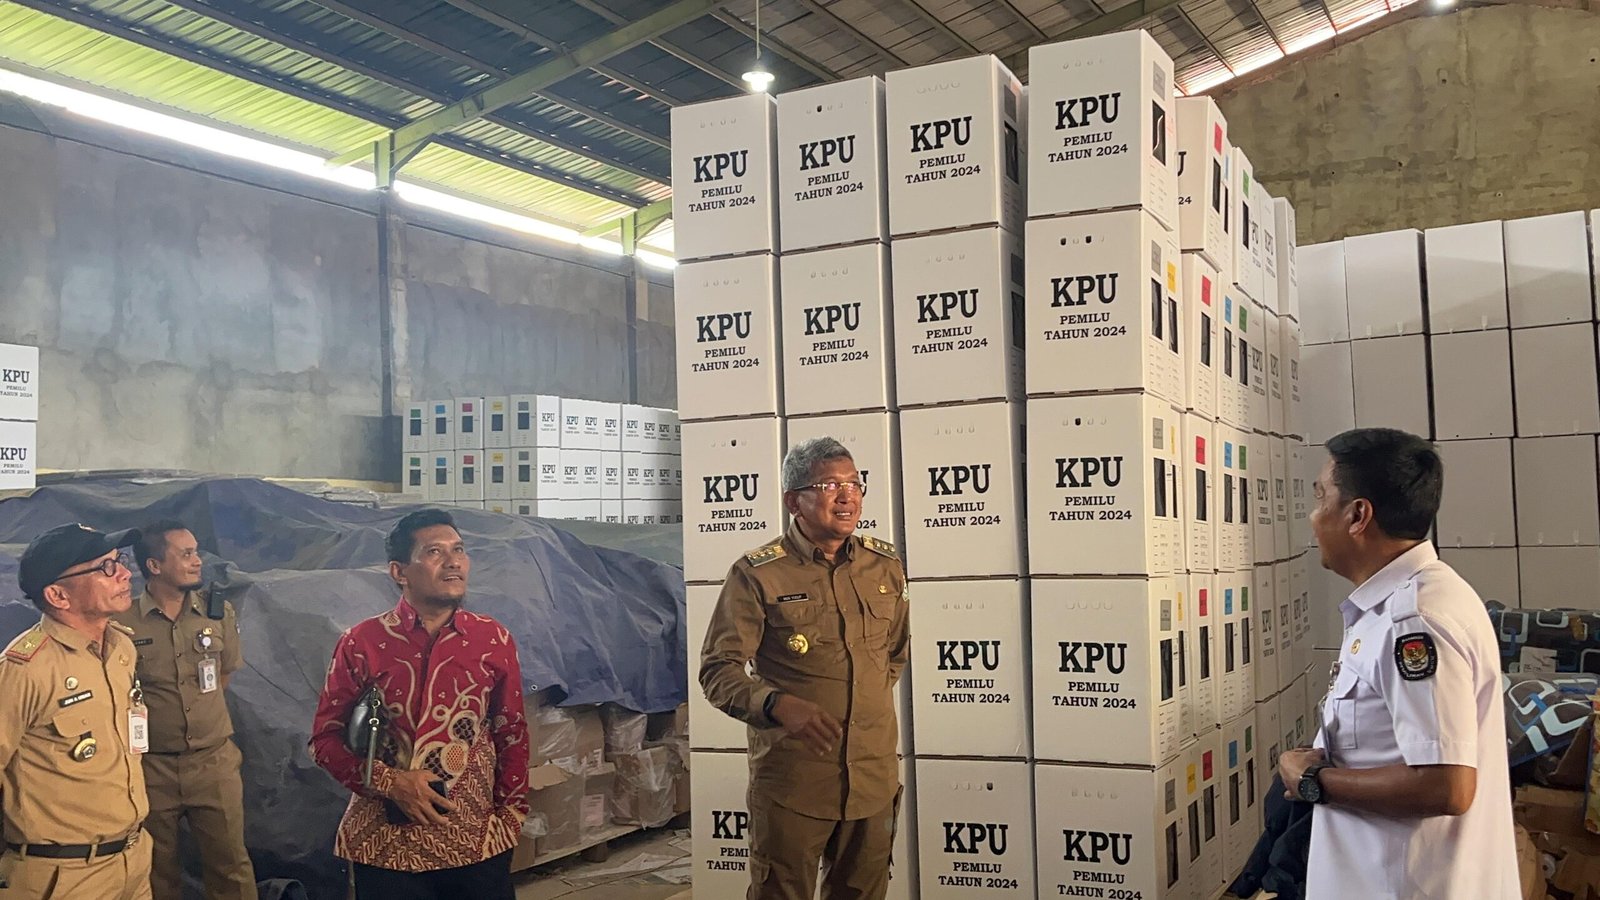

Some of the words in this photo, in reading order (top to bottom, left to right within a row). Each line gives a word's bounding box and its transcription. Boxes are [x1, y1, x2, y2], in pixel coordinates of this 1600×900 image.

[1055, 92, 1121, 130] KPU
[910, 116, 972, 153] KPU
[1064, 131, 1112, 147] PEMILU
[799, 135, 855, 171] KPU
[1048, 148, 1092, 162] TAHUN
[1096, 144, 1128, 156] 2024
[693, 150, 748, 183] KPU
[920, 153, 965, 169] PEMILU
[808, 171, 849, 186] PEMILU
[905, 170, 947, 184] TAHUN
[951, 165, 981, 177] 2024
[701, 184, 742, 198] PEMILU
[794, 187, 832, 201] TAHUN
[836, 182, 863, 194] 2024
[688, 200, 725, 212] TAHUN
[729, 196, 756, 207] 2024
[1178, 196, 1192, 205] 24
[1051, 273, 1118, 308] KPU
[917, 288, 979, 323] KPU
[804, 302, 861, 336] KPU
[1060, 312, 1110, 325] PEMILU
[696, 311, 752, 343] KPU
[926, 326, 972, 339] PEMILU
[1044, 328, 1089, 340] TAHUN
[1094, 326, 1126, 337] 2024
[813, 338, 855, 351] PEMILU
[912, 341, 953, 354] TAHUN
[958, 338, 988, 350] 2024
[705, 346, 746, 358] PEMILU
[799, 354, 838, 366] TAHUN
[841, 350, 869, 361] 2024
[692, 361, 729, 372] TAHUN
[733, 358, 759, 368] 2024
[3, 368, 30, 383] KPU
[542, 412, 555, 422] KPU
[566, 416, 579, 425] KPU
[585, 416, 597, 426] KPU
[605, 419, 617, 428] KPU
[626, 420, 638, 428] KPU
[644, 422, 655, 431] KPU
[659, 424, 670, 432] KPU
[0, 447, 27, 460] KPU
[542, 464, 555, 473] KPU
[564, 466, 577, 475] KPU
[584, 466, 597, 475] KPU
[606, 468, 618, 476] KPU
[628, 468, 639, 477] KPU
[644, 469, 654, 477] KPU
[659, 469, 670, 477] KPU
[1055, 456, 1123, 488] KPU
[928, 464, 991, 496] KPU
[703, 473, 759, 503] KPU
[938, 502, 985, 513] PEMILU
[1065, 496, 1115, 506] PEMILU
[711, 508, 753, 519] PEMILU
[1049, 511, 1094, 521] TAHUN
[1099, 510, 1132, 520] 2024
[698, 522, 736, 532] TAHUN
[739, 521, 766, 530] 2024
[856, 520, 877, 529] 024
[924, 517, 966, 527] TAHUN
[970, 515, 1001, 525] 2024
[937, 641, 1000, 671] KPU
[1058, 642, 1127, 674] KPU
[947, 679, 994, 689] PEMILU
[1068, 681, 1119, 693] PEMILU
[932, 693, 975, 703] TAHUN
[979, 693, 1010, 703] 2024
[1052, 696, 1098, 707] TAHUN
[1103, 698, 1136, 709] 2024
[712, 810, 748, 840] KP
[943, 822, 1008, 855] KPU
[720, 847, 749, 857] PEMI
[1063, 829, 1132, 865] KPU
[707, 860, 746, 871] TAHUN
[953, 862, 1002, 874] PEMILU
[938, 876, 982, 887] TAHUN
[986, 878, 1018, 889] 2024
[1073, 870, 1125, 884] PEMILU
[1057, 884, 1104, 898] TAHUN
[1108, 889, 1142, 900] 2024
